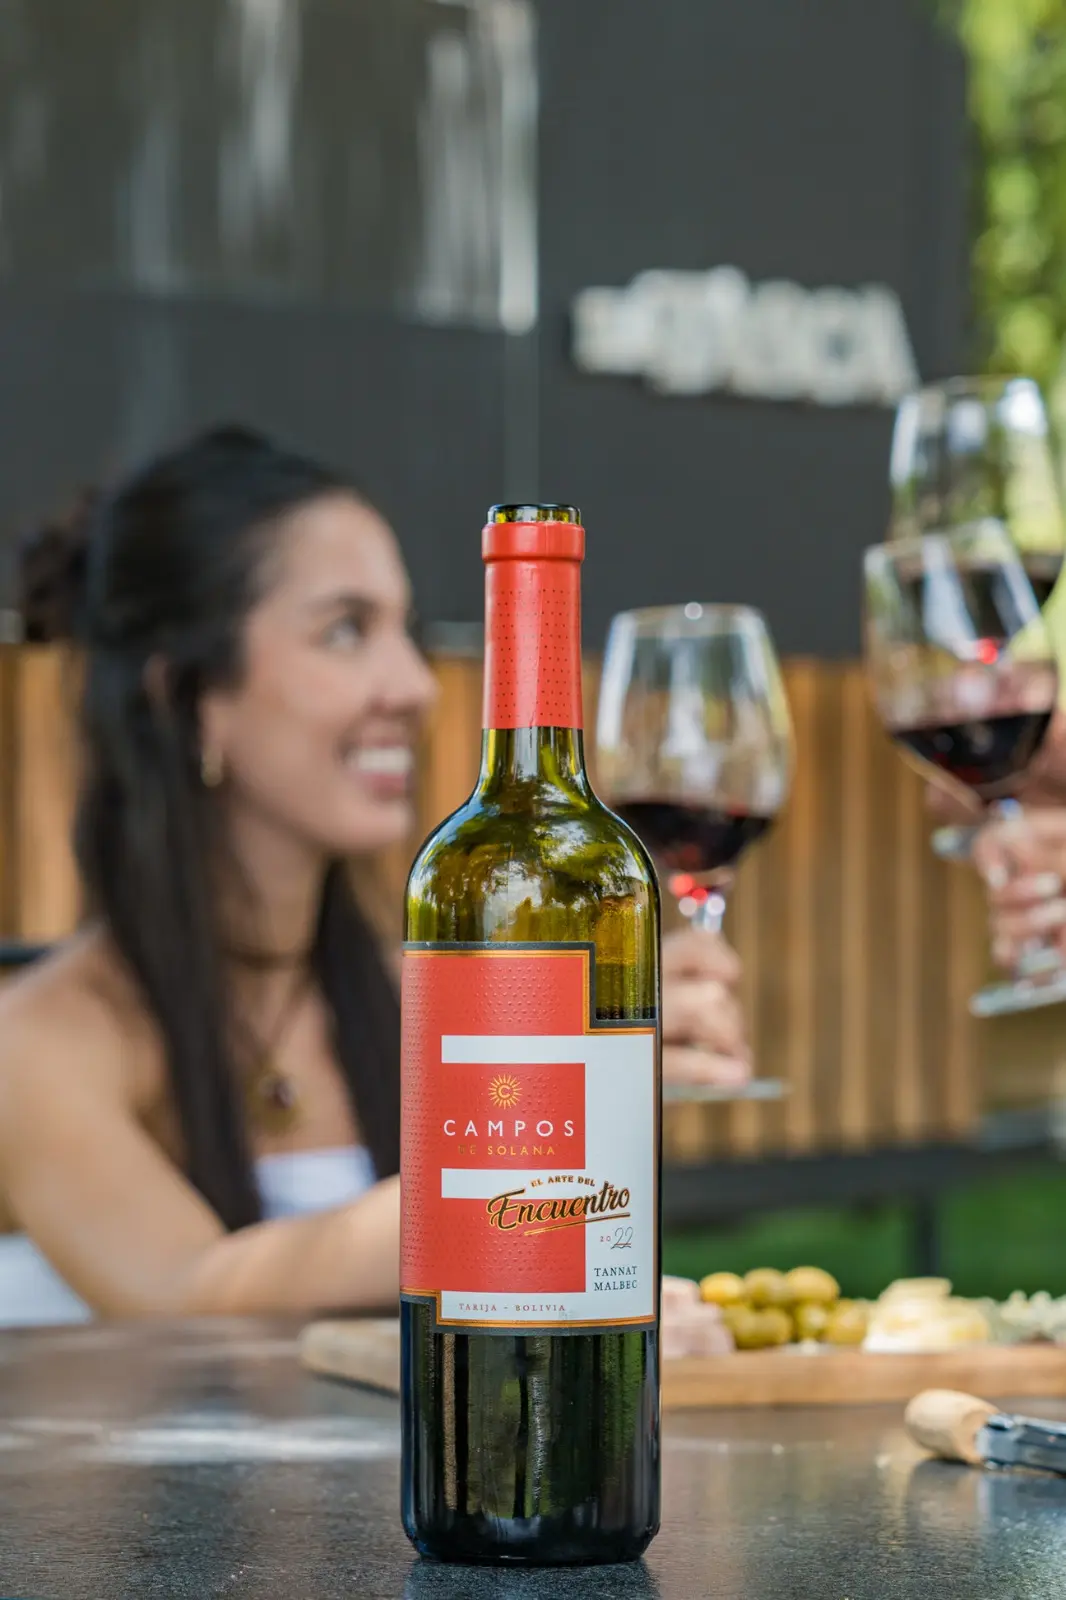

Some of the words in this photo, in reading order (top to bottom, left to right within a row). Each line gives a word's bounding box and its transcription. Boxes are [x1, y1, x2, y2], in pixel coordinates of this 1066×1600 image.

[498, 1084, 511, 1099] C
[443, 1119, 574, 1137] CAMPOS
[487, 1145, 555, 1156] SOLANA
[530, 1178, 543, 1188] EL
[547, 1175, 574, 1184] ARTE
[577, 1176, 596, 1187] DEL
[486, 1181, 631, 1231] Encuentro
[600, 1226, 634, 1250] 2022
[593, 1265, 638, 1277] TANNAT
[593, 1279, 638, 1292] MALBEC
[458, 1303, 498, 1312] TARIJA
[515, 1304, 566, 1312] BOLIVIA
